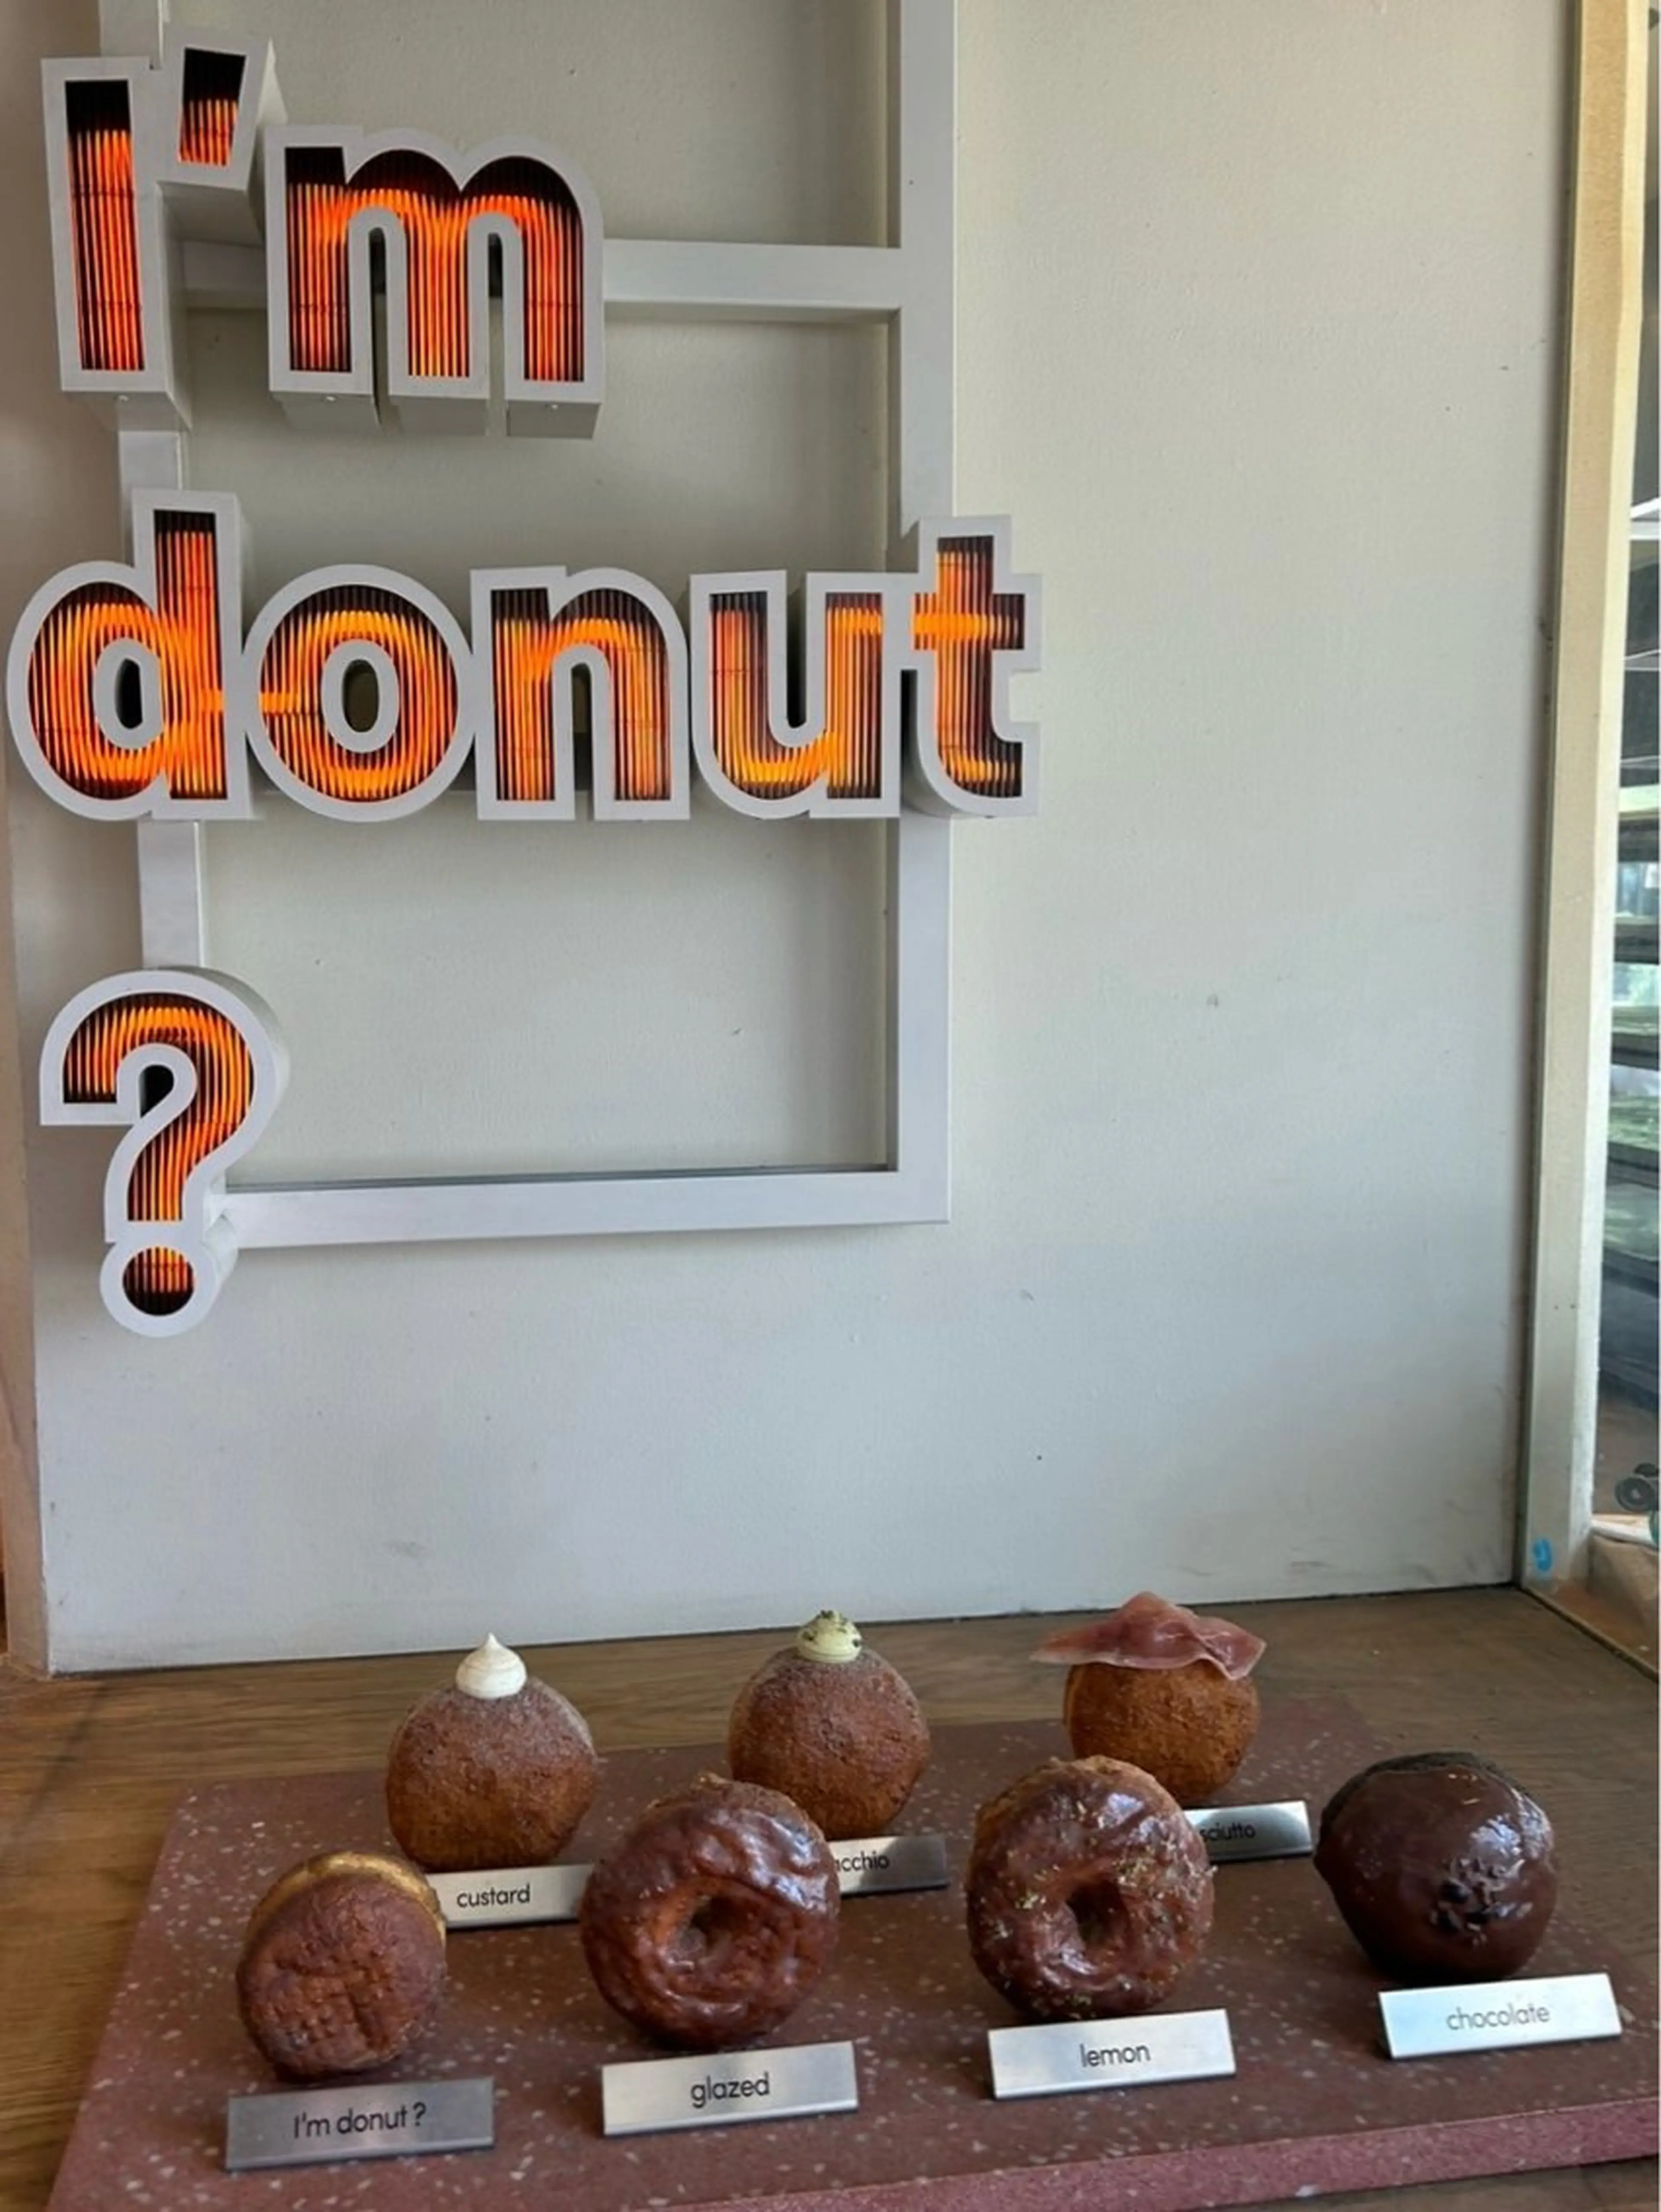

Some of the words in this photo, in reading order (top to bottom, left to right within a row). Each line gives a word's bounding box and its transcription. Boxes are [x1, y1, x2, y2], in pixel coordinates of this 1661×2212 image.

[43, 37, 601, 400] I'm
[9, 491, 1042, 819] donut
[41, 971, 277, 1337] ?
[457, 1882, 530, 1908] custard
[1446, 2002, 1550, 2030] chocolate
[1080, 2043, 1151, 2068] lemon
[691, 2072, 770, 2108] glazed
[294, 2111, 330, 2138] I'm
[336, 2104, 408, 2135] donut
